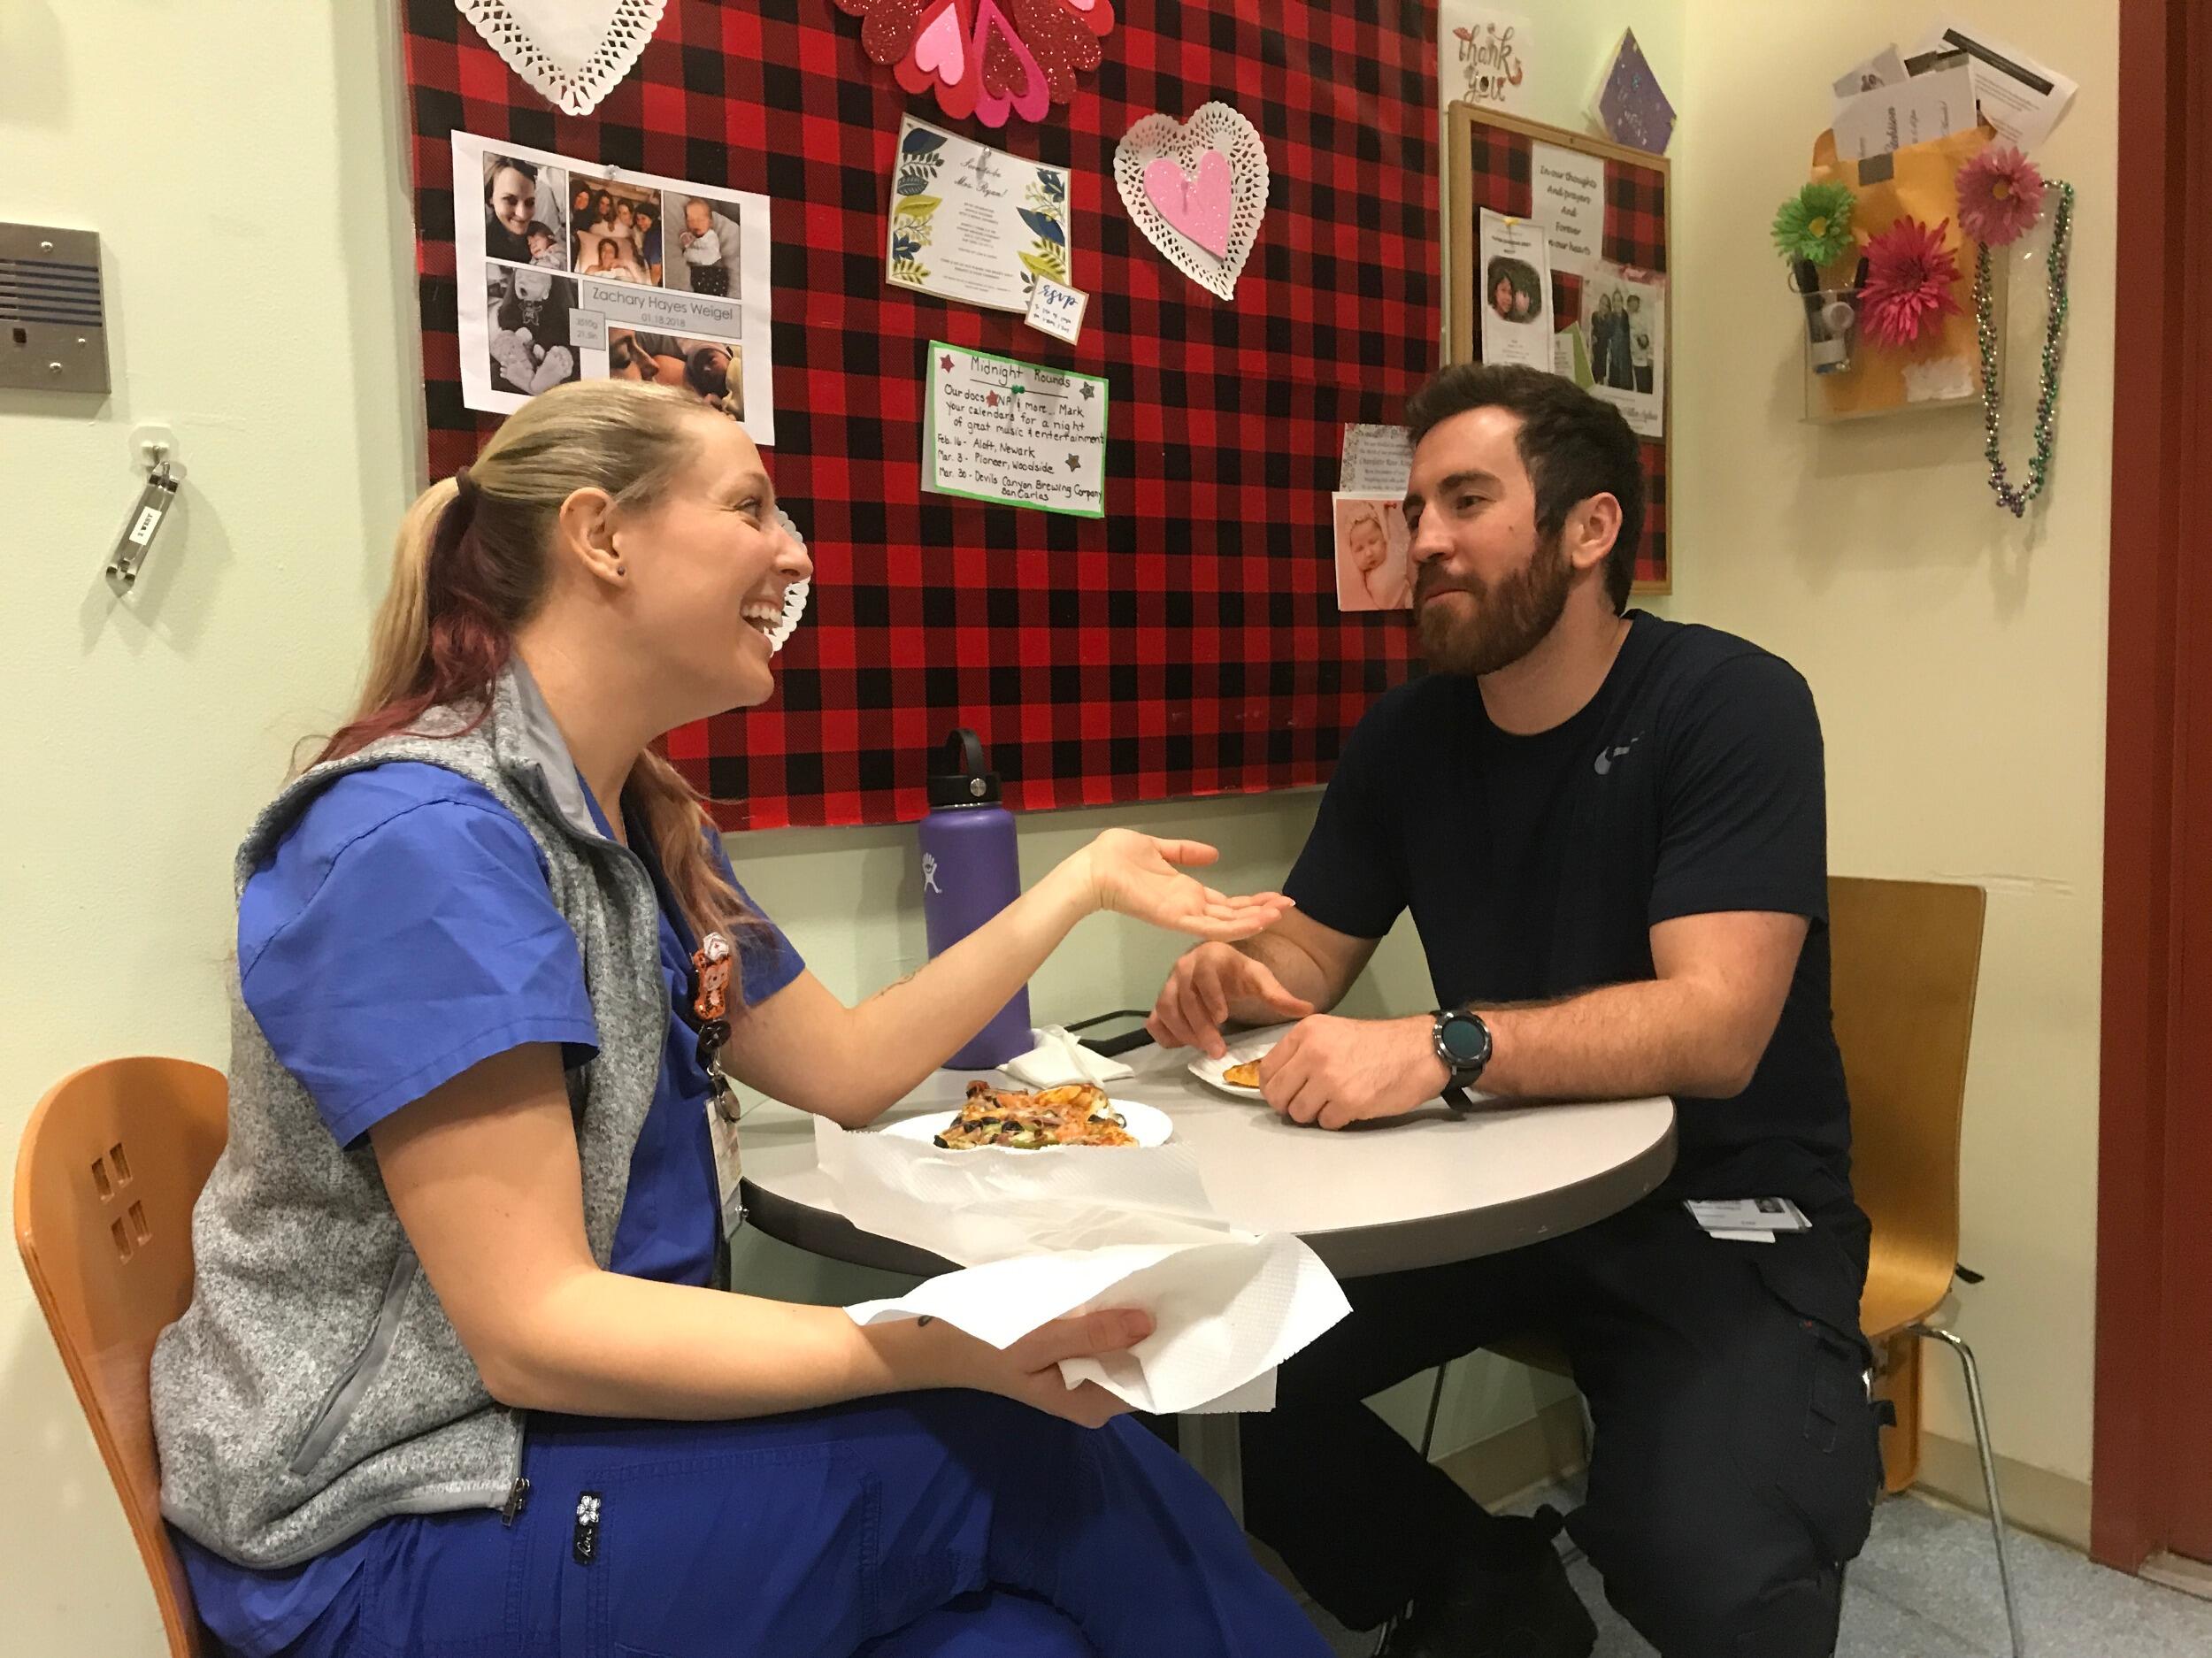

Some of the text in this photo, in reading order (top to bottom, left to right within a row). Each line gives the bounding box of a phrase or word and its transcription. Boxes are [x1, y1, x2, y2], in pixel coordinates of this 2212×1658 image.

[1549, 170, 1564, 179] our
[1565, 172, 1597, 189] thoughts
[1547, 185, 1592, 204] And prayers
[1561, 206, 1578, 218] And
[593, 287, 733, 321] Zachary Hayes Weigel
[641, 312, 687, 327] 01.18.2018
[970, 356, 1071, 388] Midnight Rounds
[944, 384, 964, 399] Our
[1058, 403, 1085, 418] Mark
[953, 417, 964, 428] of
[967, 420, 991, 434] great
[996, 424, 1024, 438] music
[1034, 429, 1105, 444] entertainment
[968, 404, 1016, 422] calendars
[1020, 411, 1037, 426] for
[1041, 418, 1050, 428] a
[1053, 416, 1086, 434] night
[1000, 442, 1036, 458] Newark
[974, 452, 1010, 470] Pioneer,
[1012, 461, 1056, 475] Woodside
[974, 471, 998, 486] Devils
[1002, 476, 1033, 492] Canyon
[1035, 480, 1071, 498] Brewing
[1073, 484, 1102, 504] Company
[141, 513, 153, 531] WEST
